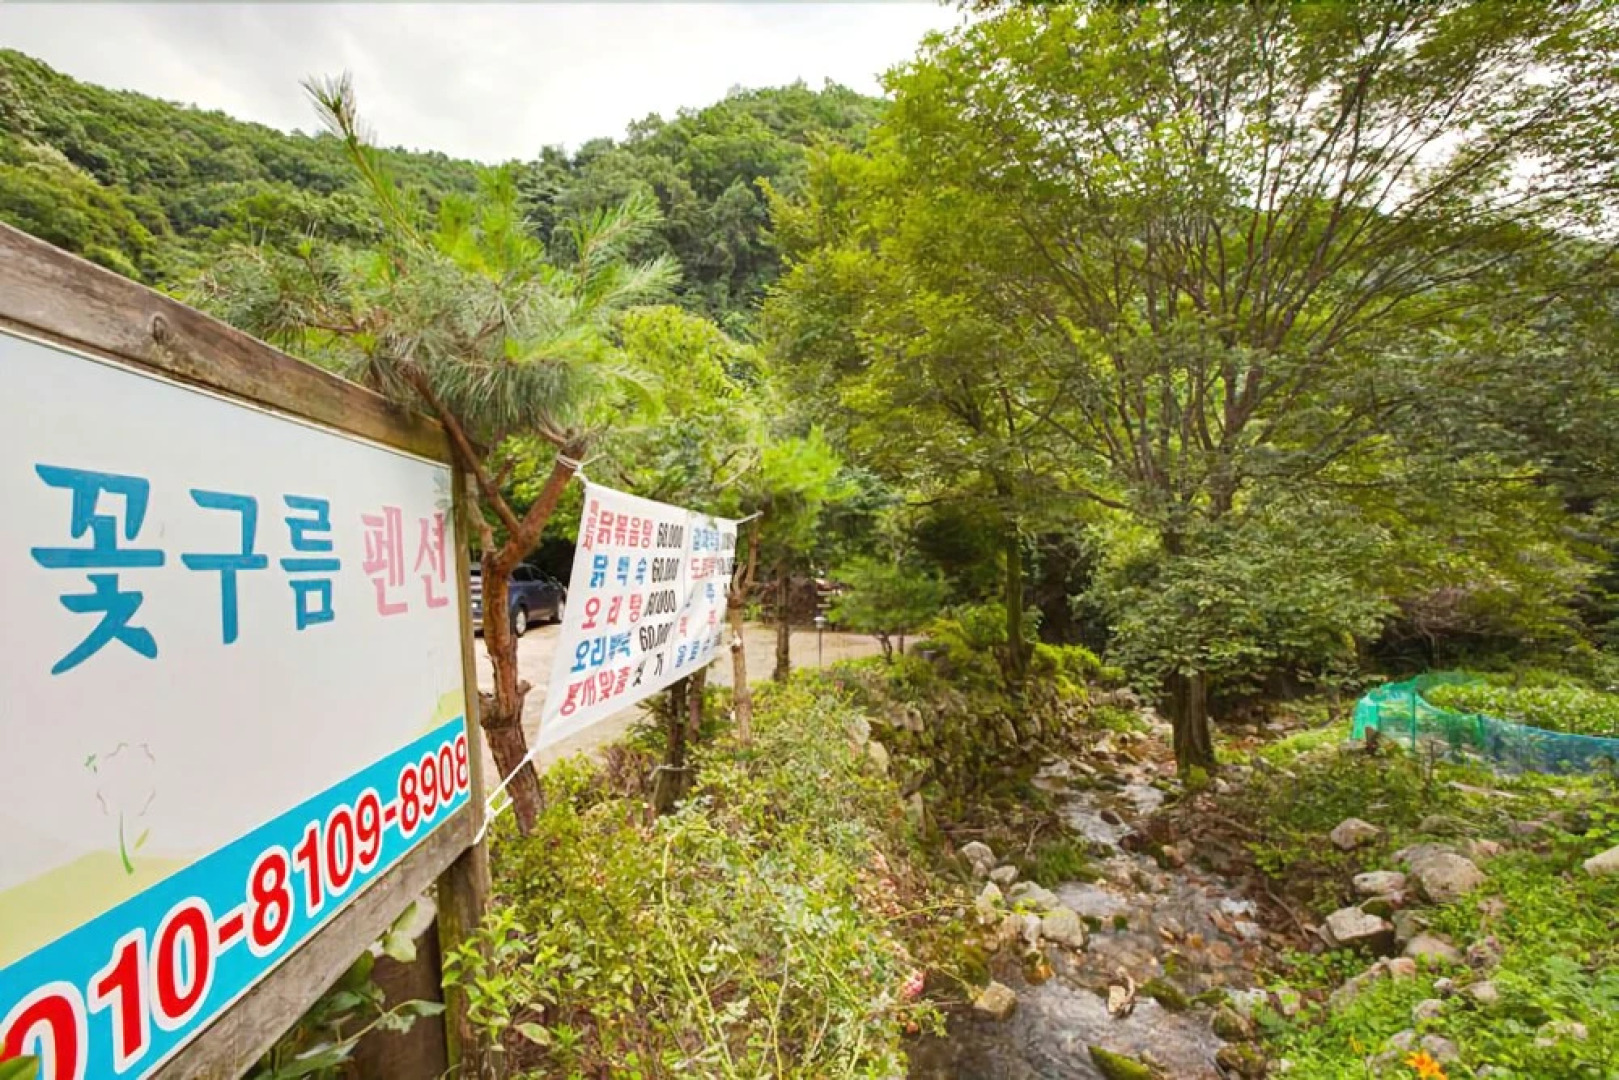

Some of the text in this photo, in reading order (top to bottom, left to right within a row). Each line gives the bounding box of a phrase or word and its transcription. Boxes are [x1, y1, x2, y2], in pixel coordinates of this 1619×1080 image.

[30, 463, 450, 676] 꽃구름 펜션
[597, 510, 653, 549] 닭볶음탕
